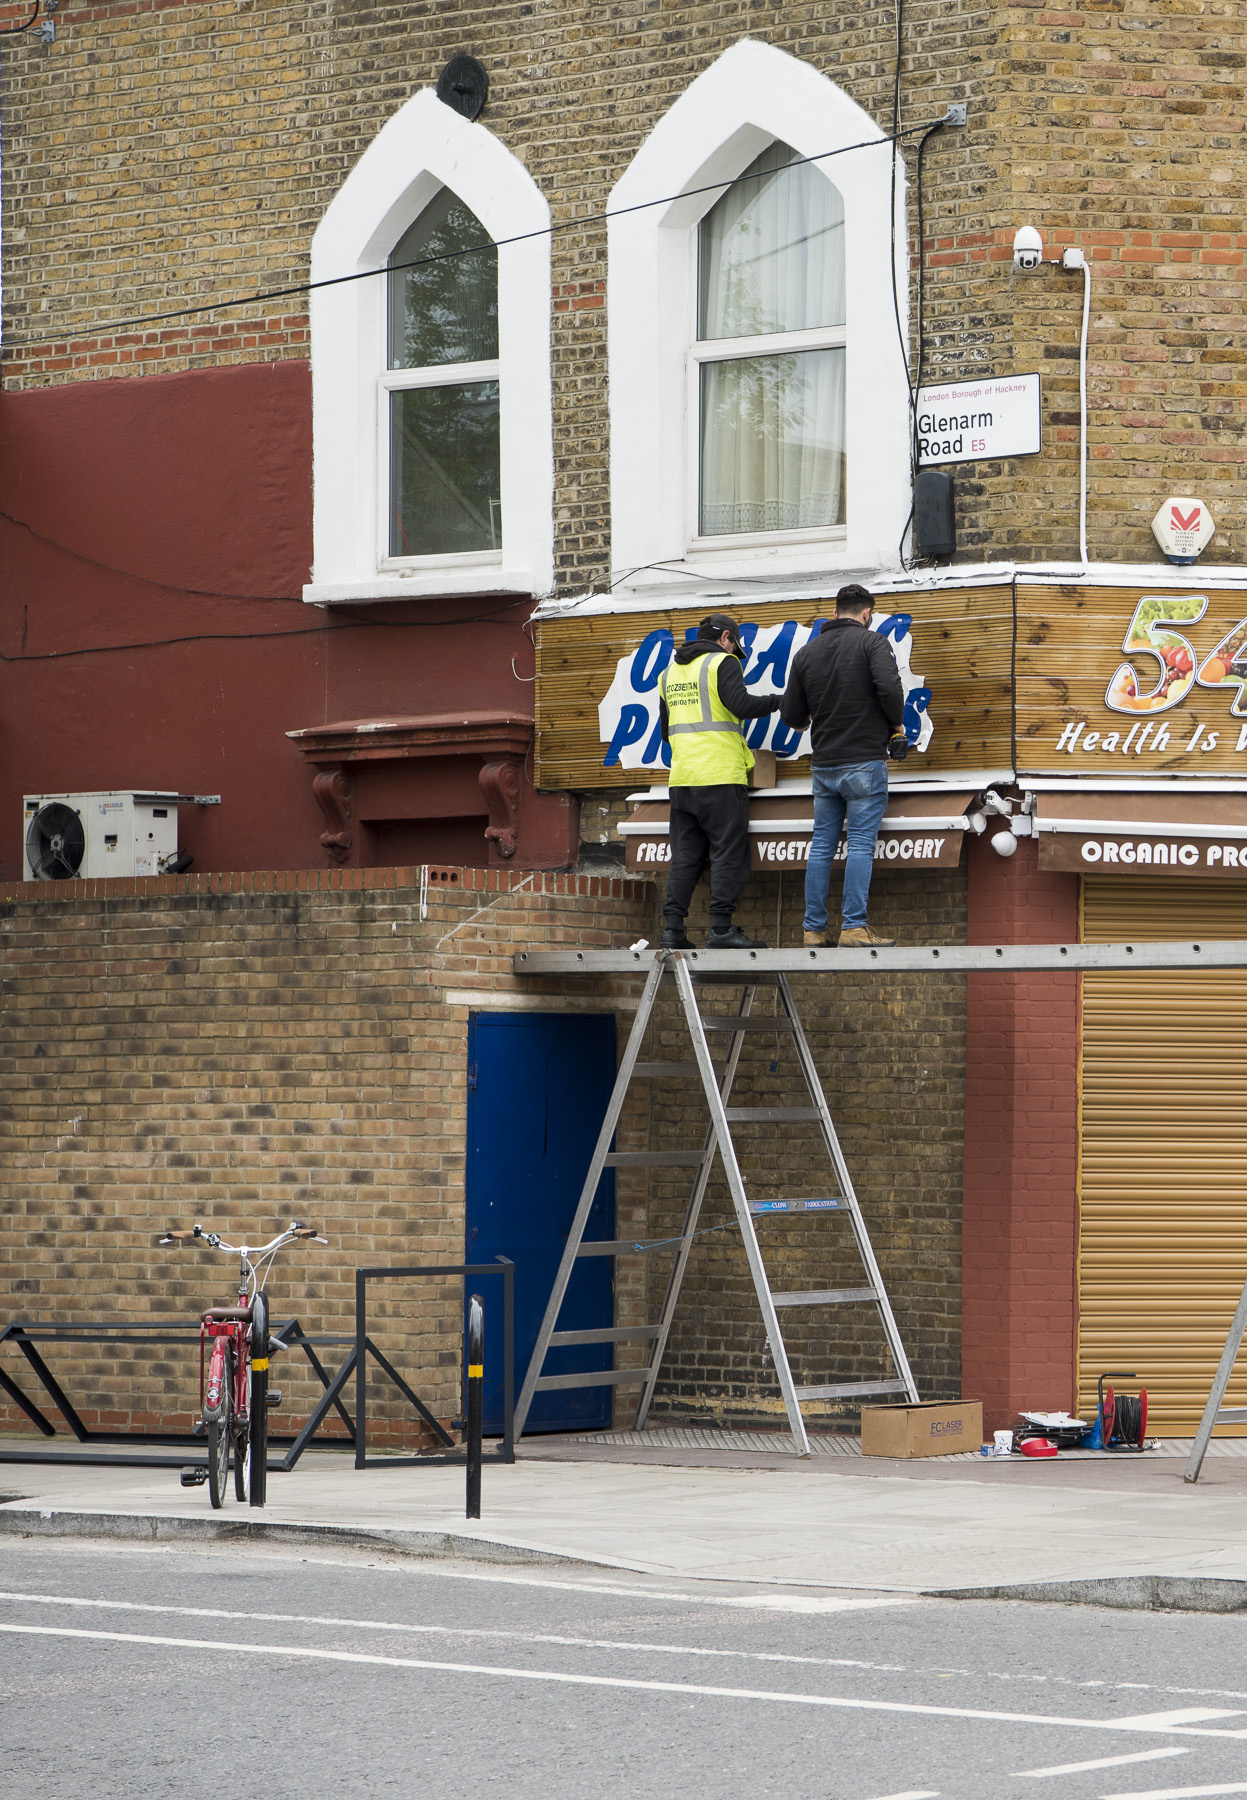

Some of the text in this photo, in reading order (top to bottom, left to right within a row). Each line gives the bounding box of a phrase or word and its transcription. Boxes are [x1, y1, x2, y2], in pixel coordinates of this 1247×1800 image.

[923, 384, 1026, 402] London Borough of Hackney
[919, 412, 993, 434] Glenarm
[919, 434, 986, 457] Road E5
[1055, 722, 1172, 755] Health
[1186, 723, 1219, 754] Is
[636, 842, 672, 862] FRES
[874, 838, 946, 860] ROCERY
[1081, 841, 1199, 866] ORGANIC
[804, 1200, 838, 1208] FABRICATIONS
